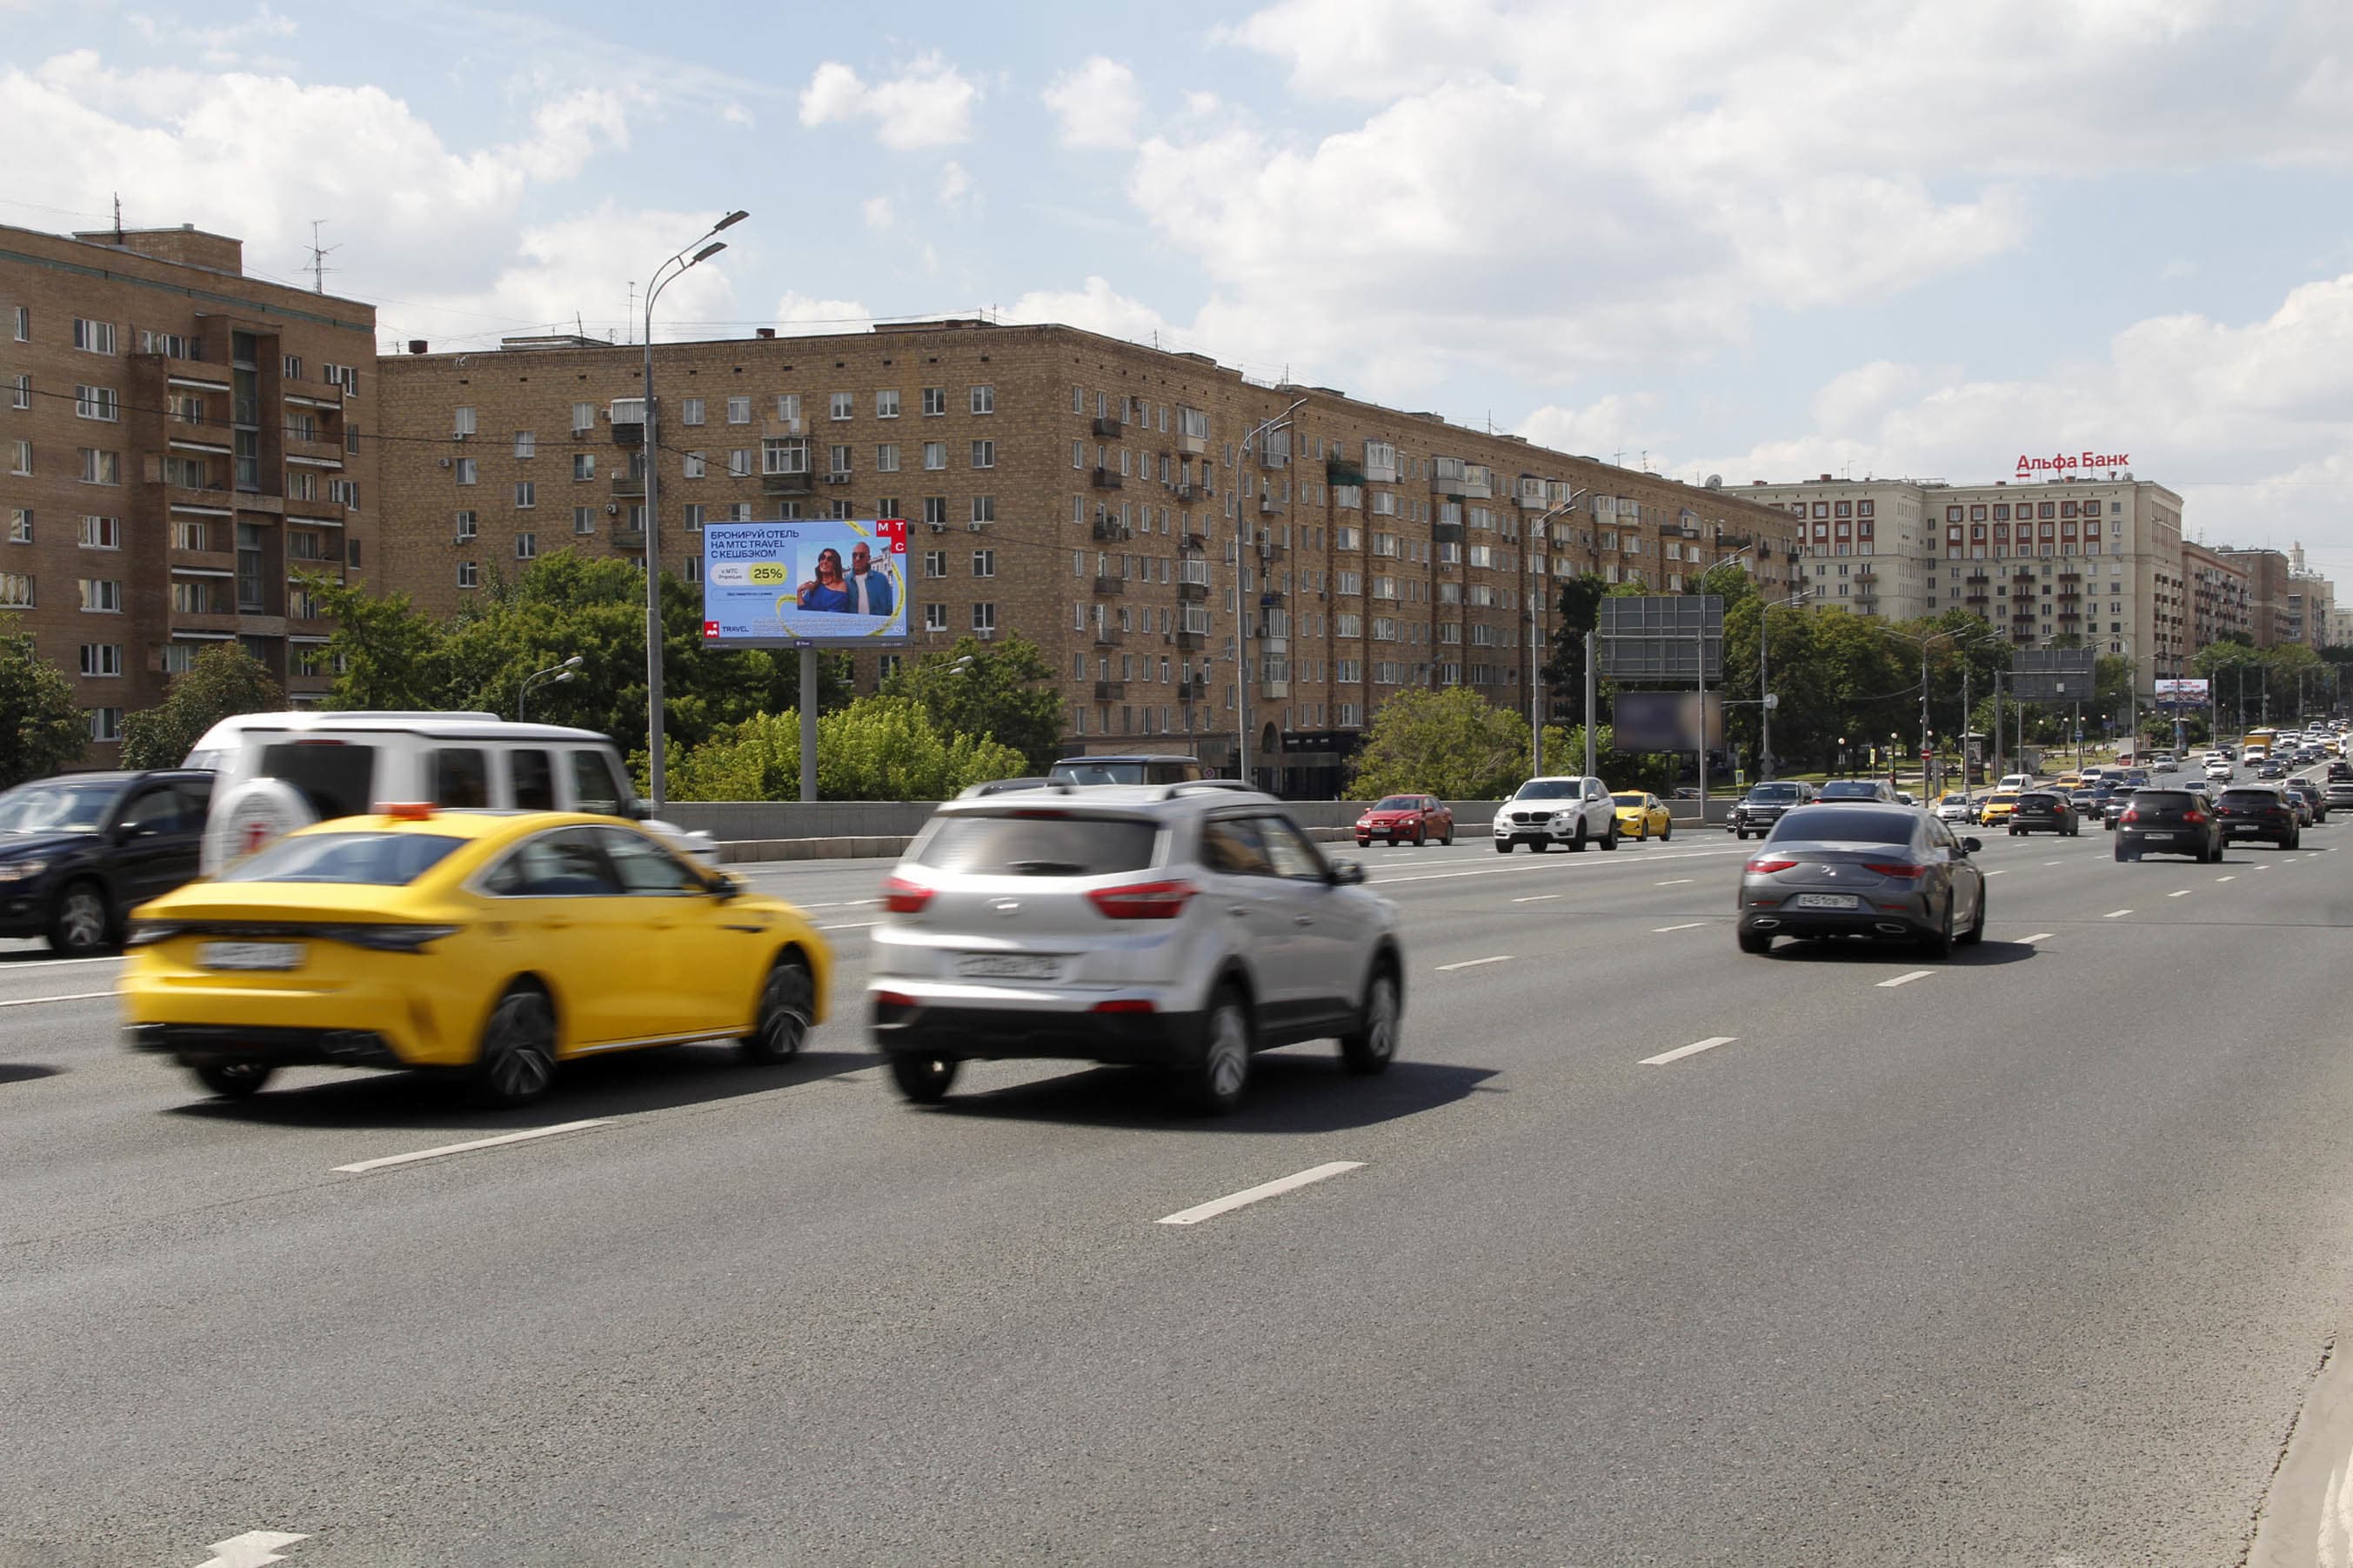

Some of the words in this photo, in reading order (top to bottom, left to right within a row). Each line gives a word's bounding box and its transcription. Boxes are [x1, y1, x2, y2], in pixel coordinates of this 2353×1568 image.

[2016, 453, 2077, 477] Альфа
[2082, 452, 2129, 467] Банк
[711, 529, 765, 540] БРОНИРУЙ
[766, 530, 799, 538] ОТЕЛЬ
[719, 550, 777, 558] КЕШБЭКОМ
[754, 568, 783, 579] 25%
